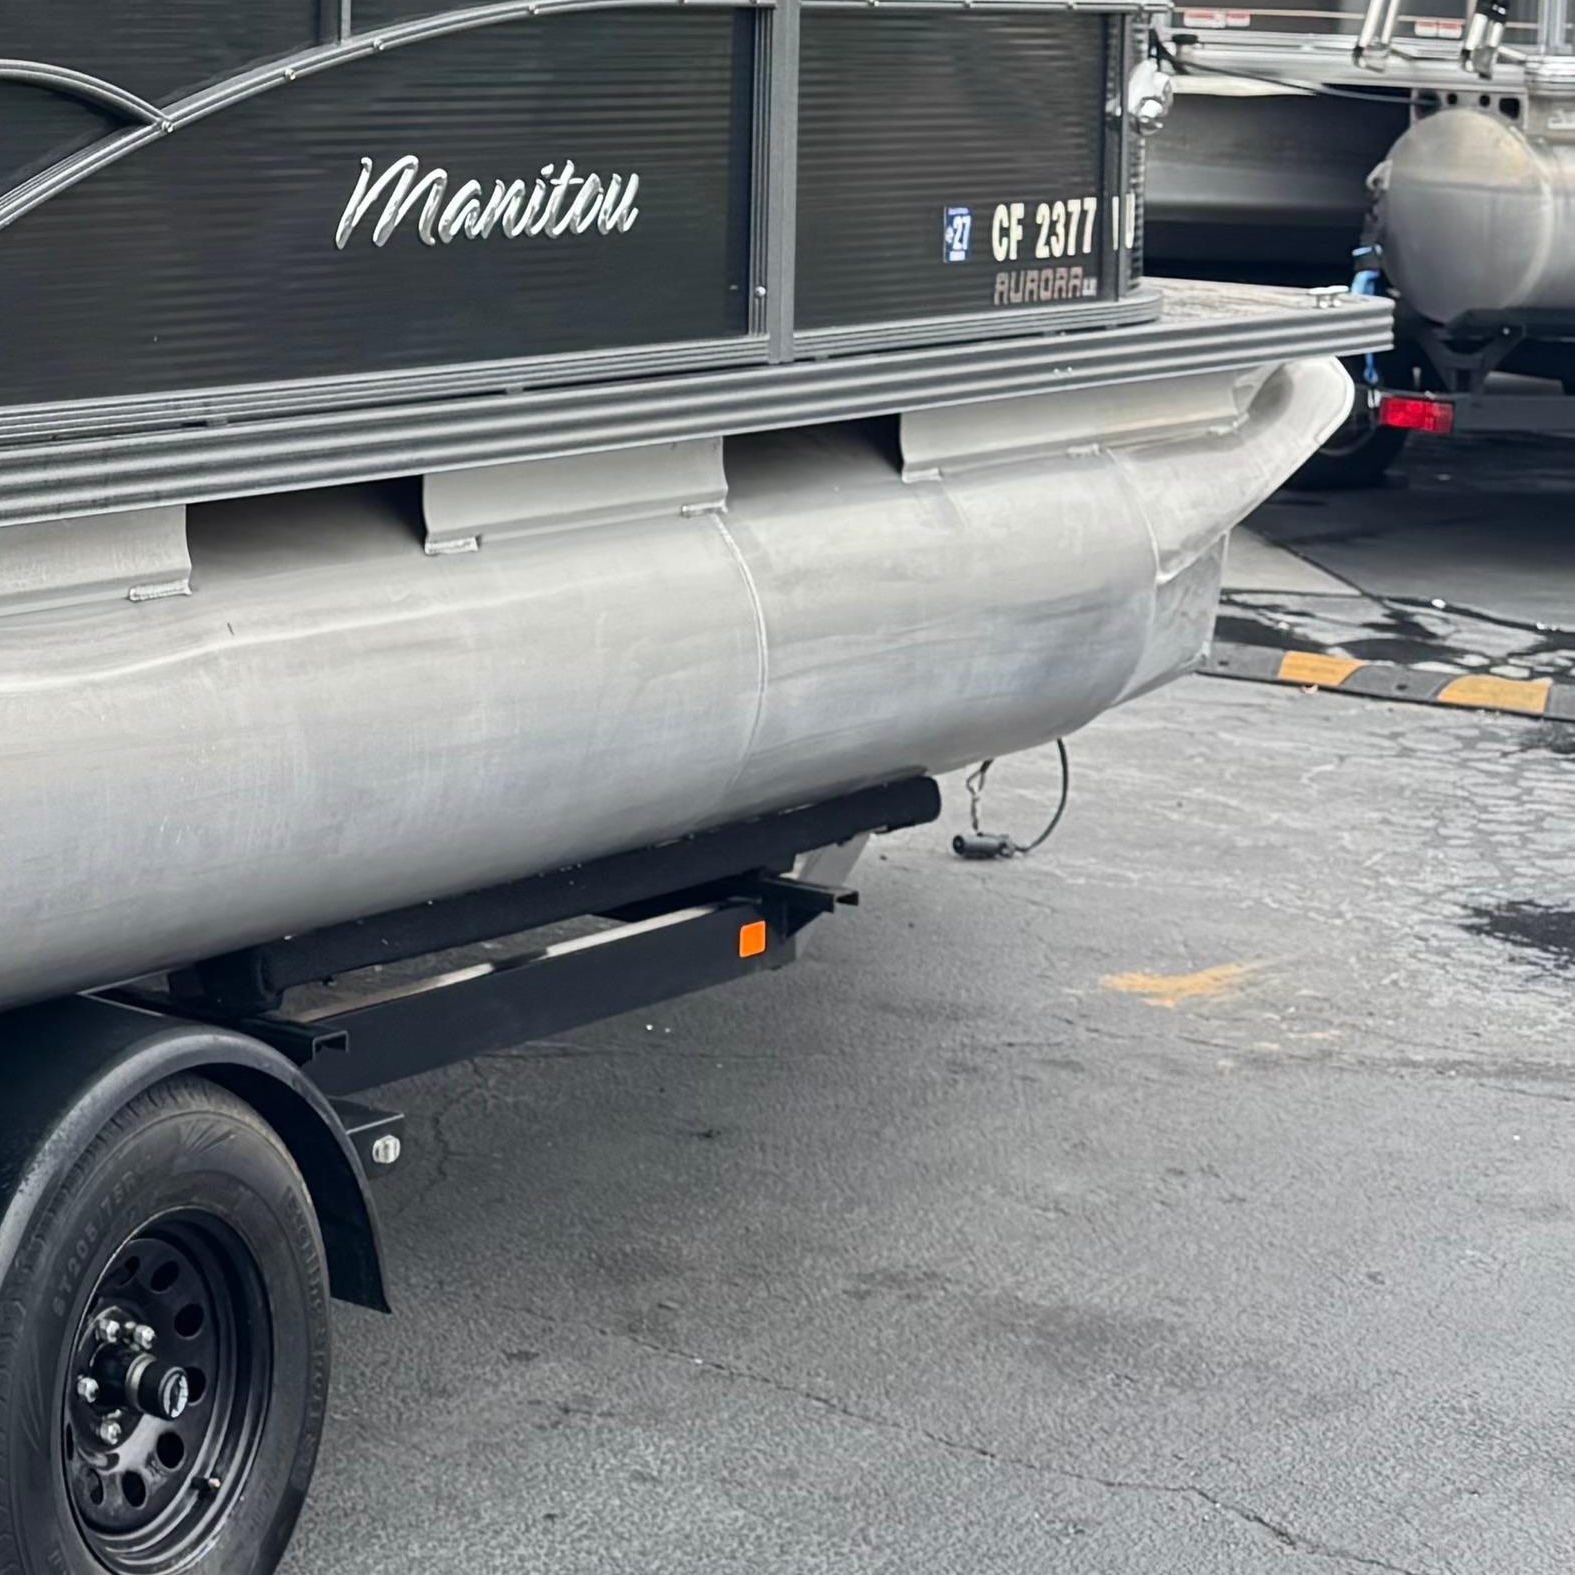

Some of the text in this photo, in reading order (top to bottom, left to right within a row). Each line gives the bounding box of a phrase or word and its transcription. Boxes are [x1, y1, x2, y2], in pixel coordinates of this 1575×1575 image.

[334, 153, 640, 249] Manitou
[952, 214, 972, 251] 27
[992, 202, 1025, 262] CF
[1035, 196, 1097, 259] 2377
[993, 266, 1083, 306] AURORA
